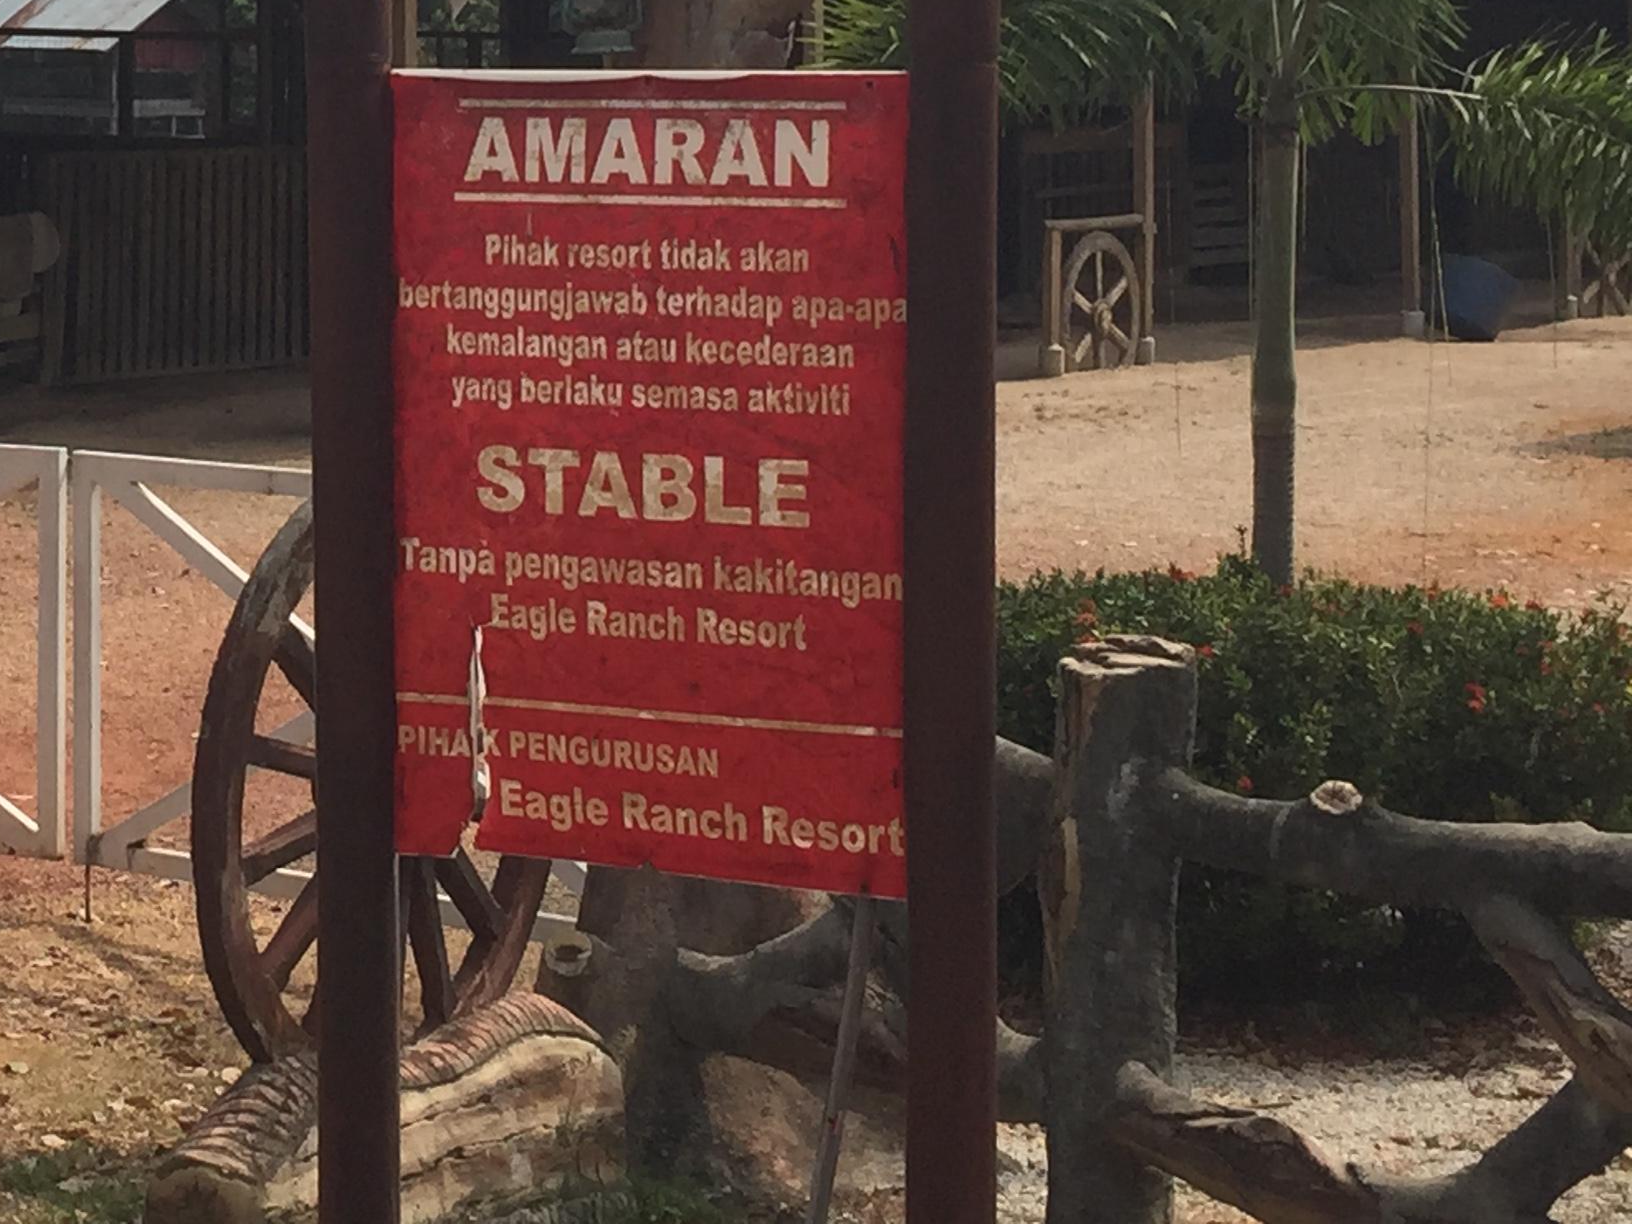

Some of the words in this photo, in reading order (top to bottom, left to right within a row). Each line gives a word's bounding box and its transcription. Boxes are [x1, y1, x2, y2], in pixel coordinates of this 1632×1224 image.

[463, 115, 831, 188] AMARAN
[484, 233, 560, 268] Pihak
[568, 239, 653, 272] resort
[660, 239, 731, 273] tidak
[740, 242, 810, 274] akan
[398, 278, 648, 321] bertanggungjawab
[656, 285, 783, 327] terhadap
[791, 294, 908, 329] apa-apa
[446, 322, 608, 367] kemalangan
[616, 330, 677, 363] atau
[685, 332, 855, 369] kecederaan
[451, 376, 512, 410] yang
[520, 373, 622, 408] berlaku
[630, 382, 738, 413] semasa
[747, 381, 851, 416] aktiviti
[476, 444, 811, 529] STABLE
[400, 536, 495, 583] Tanpa
[504, 547, 703, 591] pengawasan
[713, 556, 903, 609] kakitangan
[489, 593, 576, 642] Eagle
[586, 600, 685, 643] Ranch
[696, 607, 807, 651] Resort
[508, 731, 719, 777] PENGURUSAN
[499, 778, 609, 831] Eagle
[621, 791, 748, 842] Ranch
[761, 805, 906, 858] Resort
